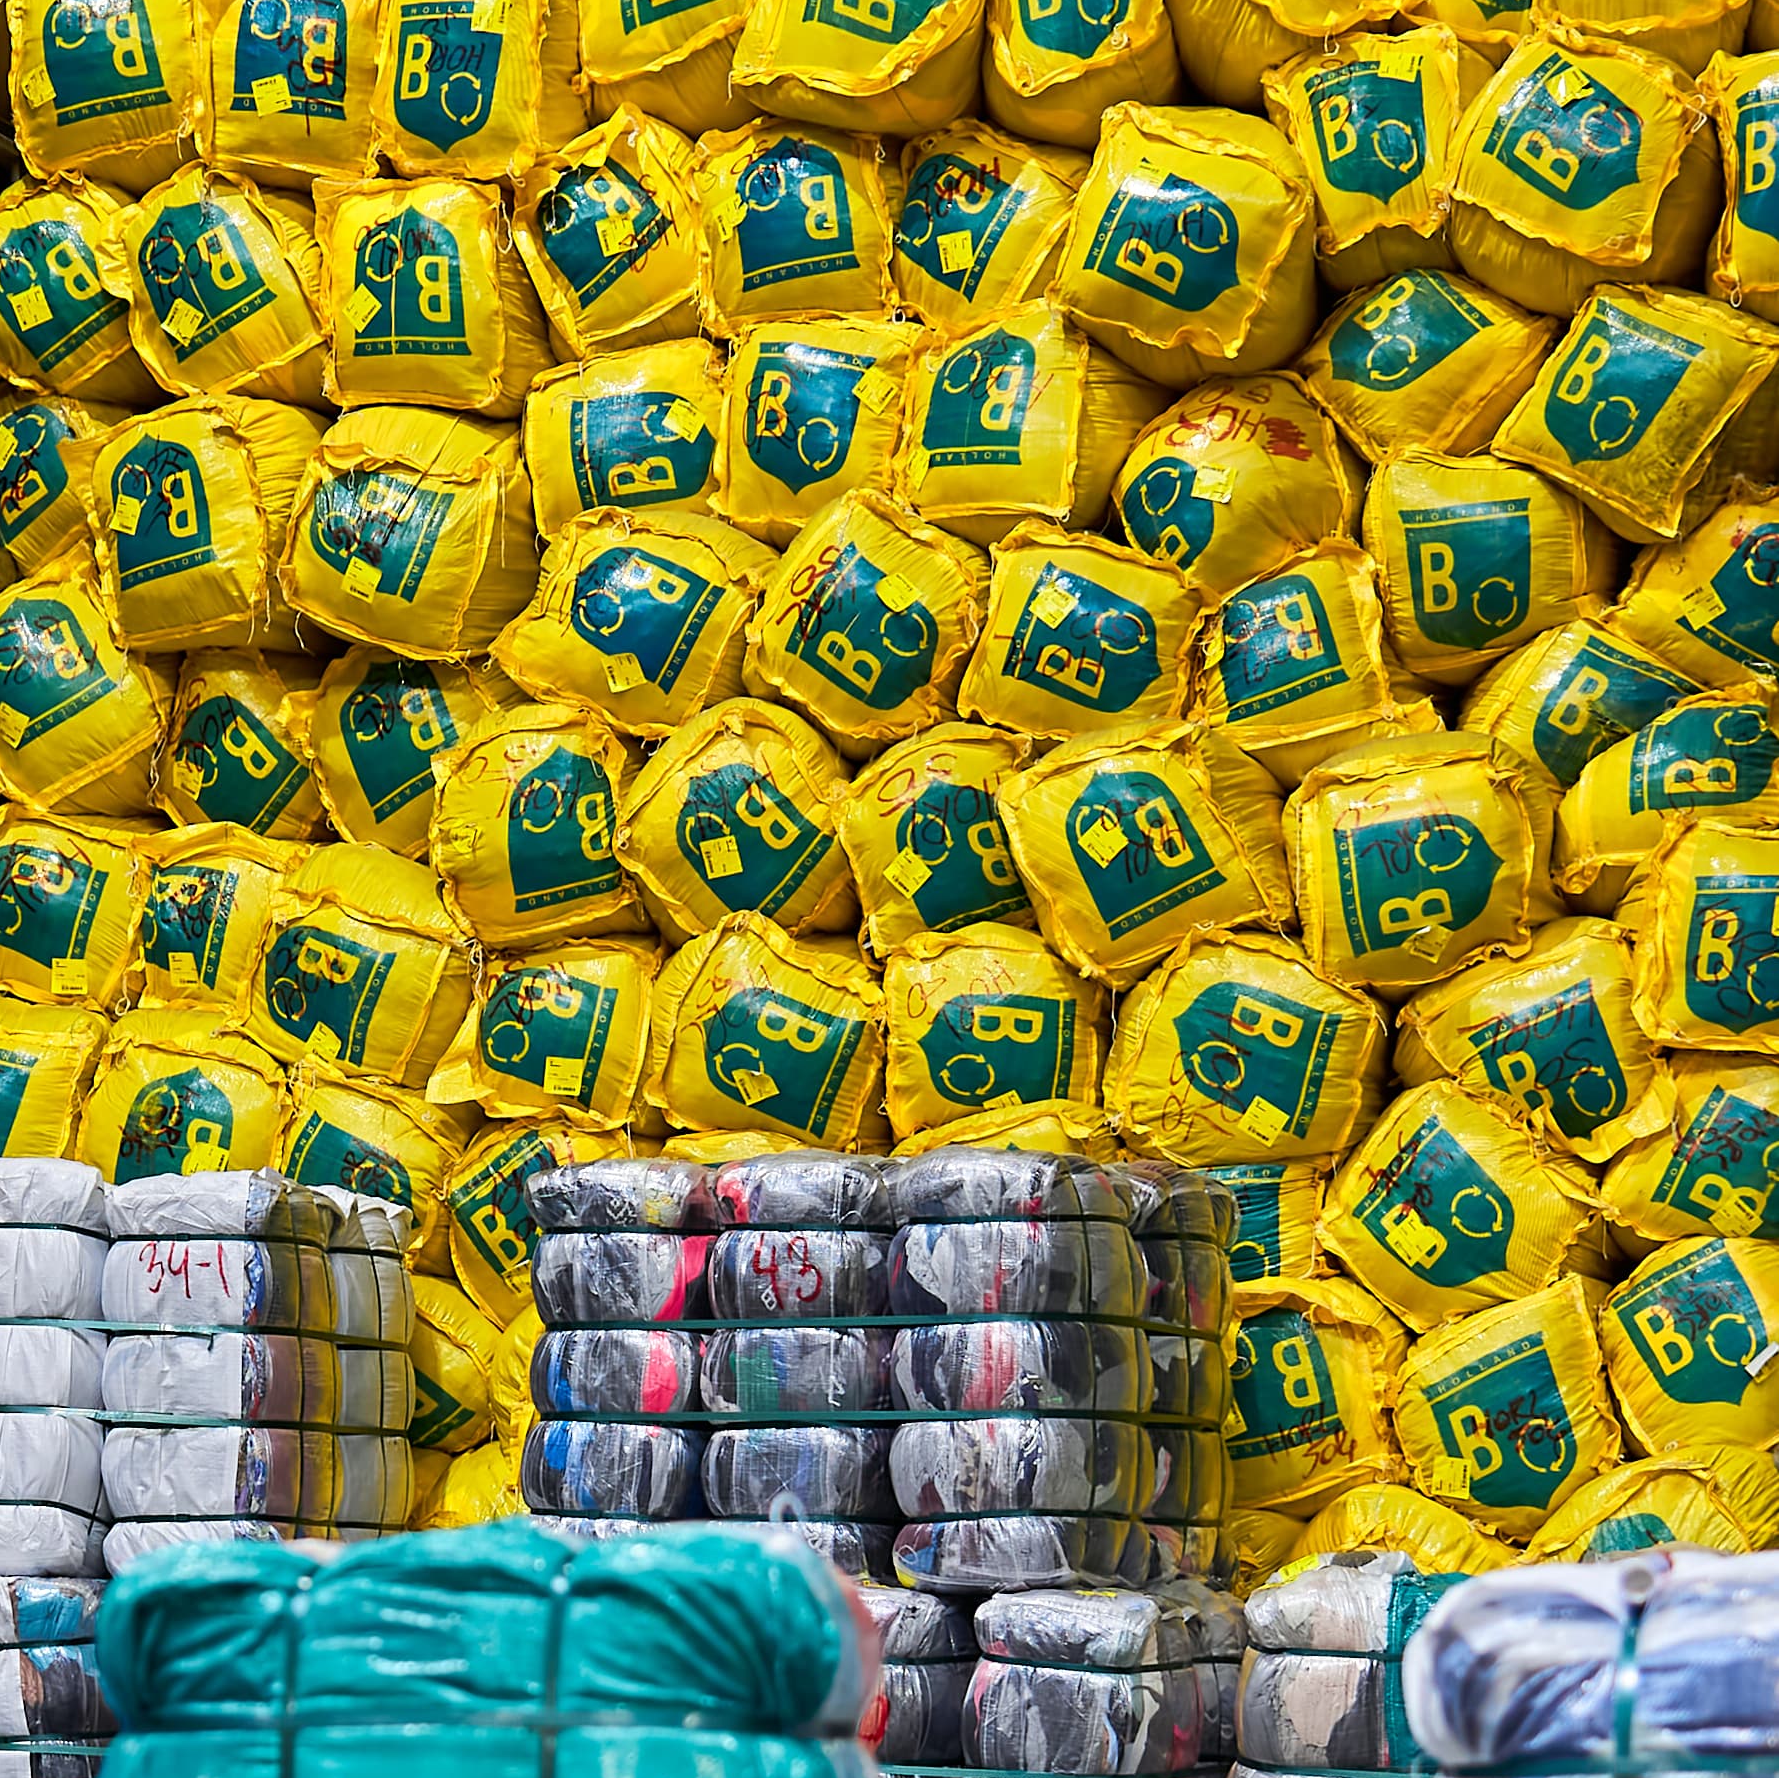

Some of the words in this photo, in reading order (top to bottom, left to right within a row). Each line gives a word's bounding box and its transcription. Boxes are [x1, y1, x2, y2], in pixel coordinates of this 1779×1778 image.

[106, 12, 148, 78] B
[303, 17, 337, 85] B
[400, 33, 432, 100] B
[68, 94, 157, 120] HOLLAND
[1318, 94, 1358, 163] B
[1513, 129, 1580, 193] B
[1744, 120, 1777, 195] B
[800, 174, 839, 240] B
[45, 238, 102, 302] B
[196, 224, 246, 291] B
[415, 254, 451, 323] B
[753, 259, 844, 285] HOLLAND
[1115, 237, 1183, 295] B
[1355, 277, 1415, 332] B
[364, 340, 455, 352] HOLLAND
[1556, 334, 1611, 405] B
[756, 370, 791, 437] B
[981, 366, 1024, 431] B
[608, 456, 677, 497] B
[933, 450, 1007, 463] HOLLAN
[162, 469, 198, 538] B
[1415, 503, 1518, 523] HOLLAND
[1419, 543, 1458, 614] B
[665, 594, 715, 679] HOLLAND
[1276, 592, 1324, 659] B
[817, 629, 883, 695] B
[1036, 643, 1106, 699] B
[1238, 674, 1333, 715] HOLLAND
[399, 685, 445, 751] B
[1548, 665, 1609, 736] B
[222, 715, 279, 779] B
[1663, 757, 1737, 794] B
[576, 792, 612, 861] B
[735, 782, 802, 850] B
[1135, 796, 1194, 868] B
[765, 845, 823, 911] HOLLAN
[967, 821, 1018, 888] B
[72, 880, 100, 956] HOLLAN
[1120, 878, 1211, 929] HOLLAND
[1339, 840, 1362, 942] HOLLAND
[1378, 888, 1454, 935] B
[297, 936, 360, 985] B
[1697, 910, 1739, 983] B
[351, 962, 387, 1054] HOLLAND
[516, 976, 583, 1018] B
[757, 1000, 829, 1053] B
[972, 1005, 1044, 1046] B
[1231, 994, 1304, 1048] B
[814, 1030, 858, 1126] HOLLAND
[1058, 1011, 1072, 1097] HOLLAN
[1299, 1025, 1333, 1124] HOLLAND
[472, 1205, 528, 1271] B
[1272, 1336, 1321, 1409] B
[1436, 1339, 1532, 1395] HOLLAND
[1634, 1304, 1694, 1377] B
[1448, 1403, 1503, 1482] B
